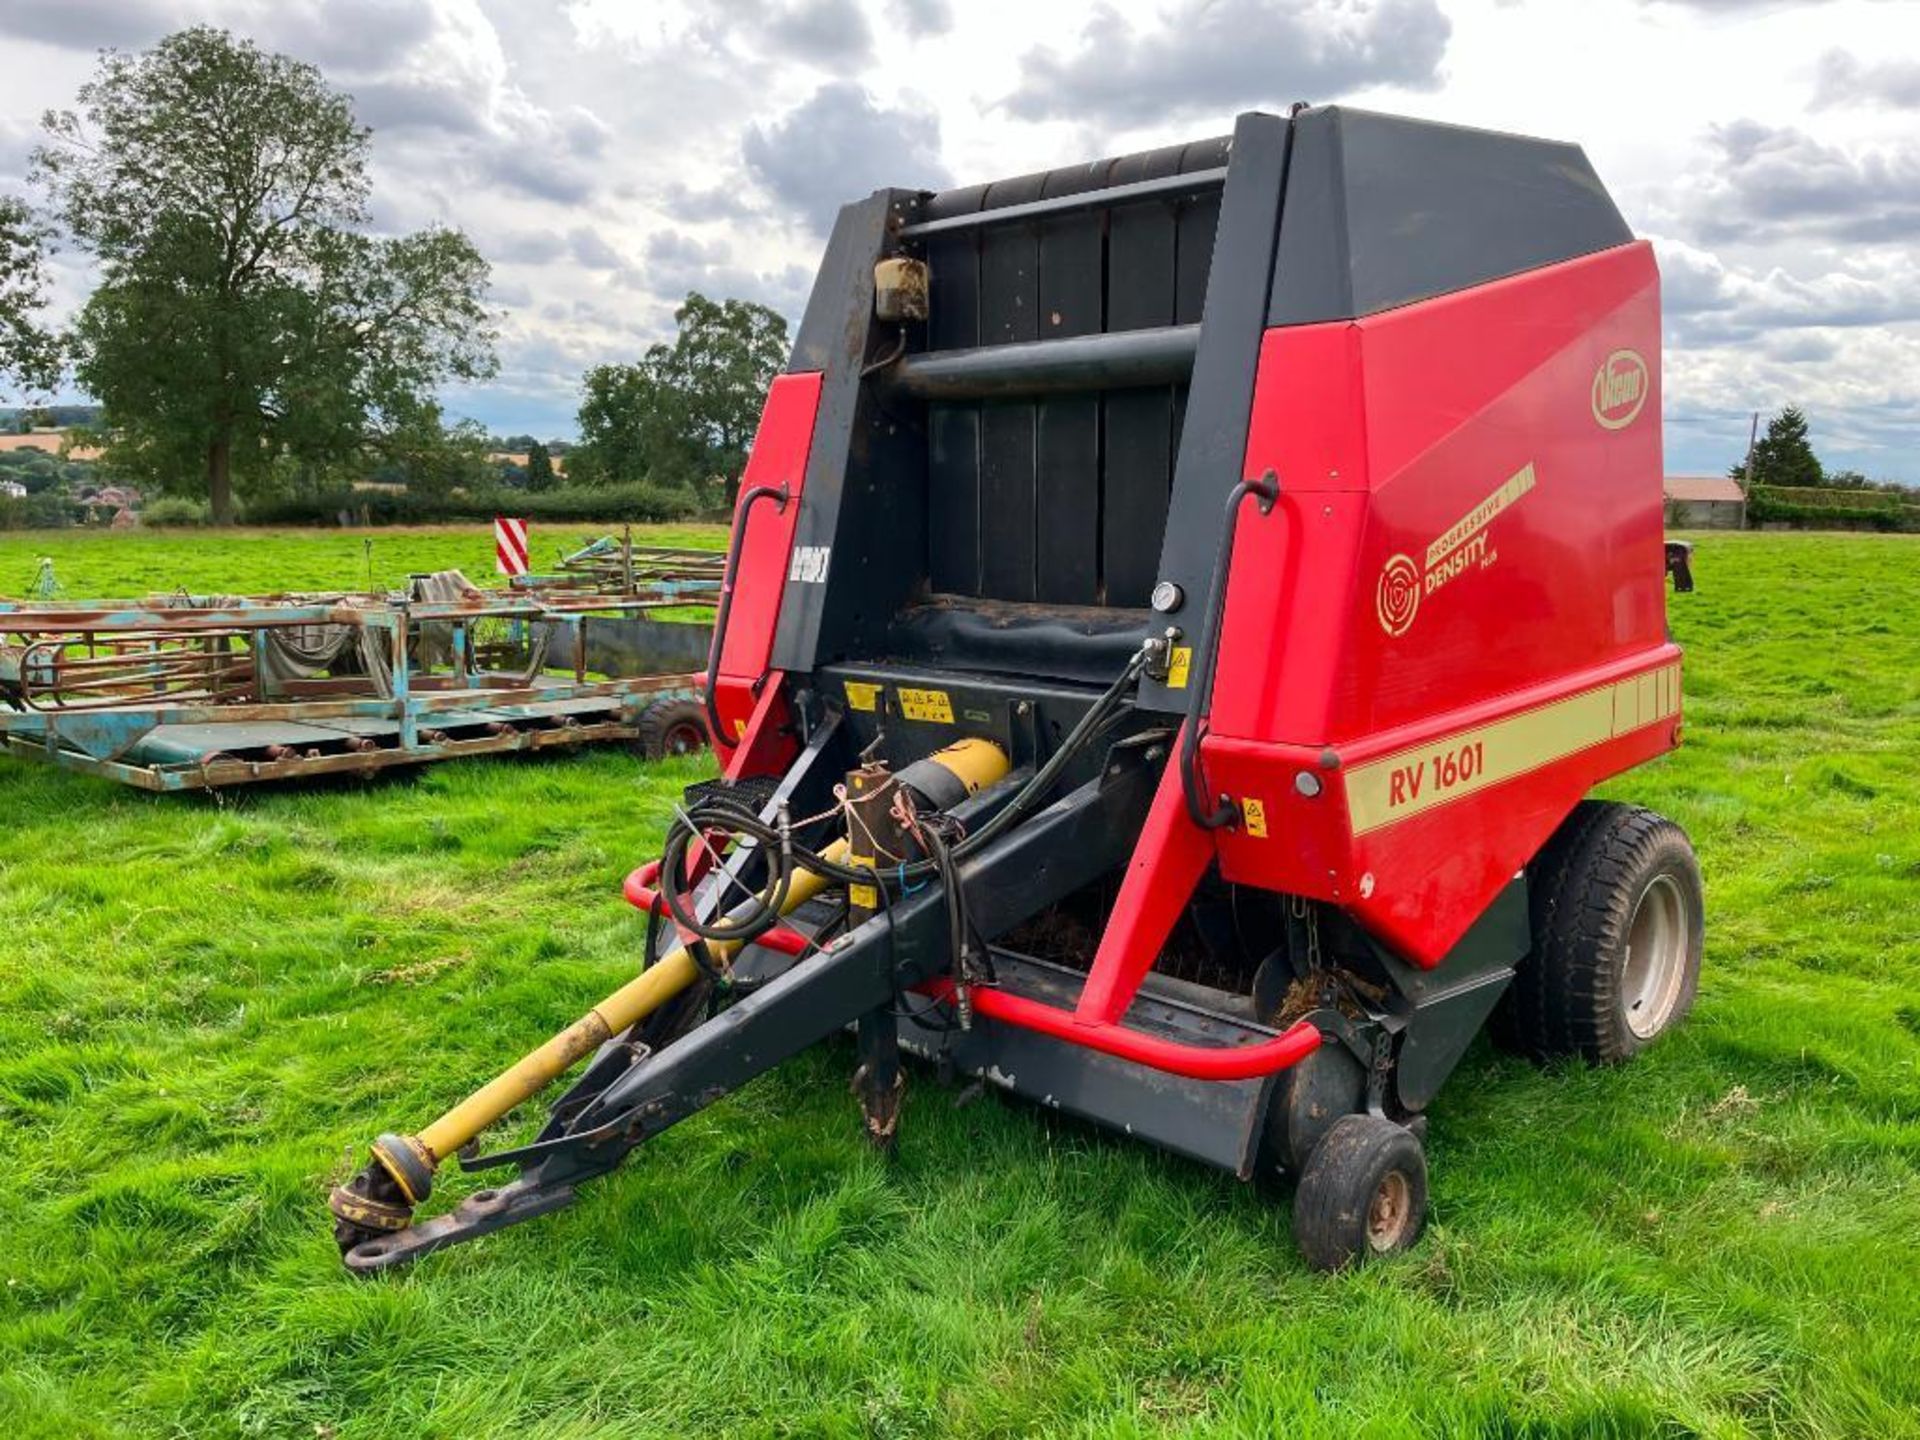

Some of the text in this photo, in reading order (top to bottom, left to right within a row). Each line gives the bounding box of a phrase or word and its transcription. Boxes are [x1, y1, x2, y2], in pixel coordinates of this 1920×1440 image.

[1428, 495, 1501, 560] PROGRESSIVE
[1425, 529, 1489, 595] DENSITY
[1389, 742, 1483, 808] RV 1601
